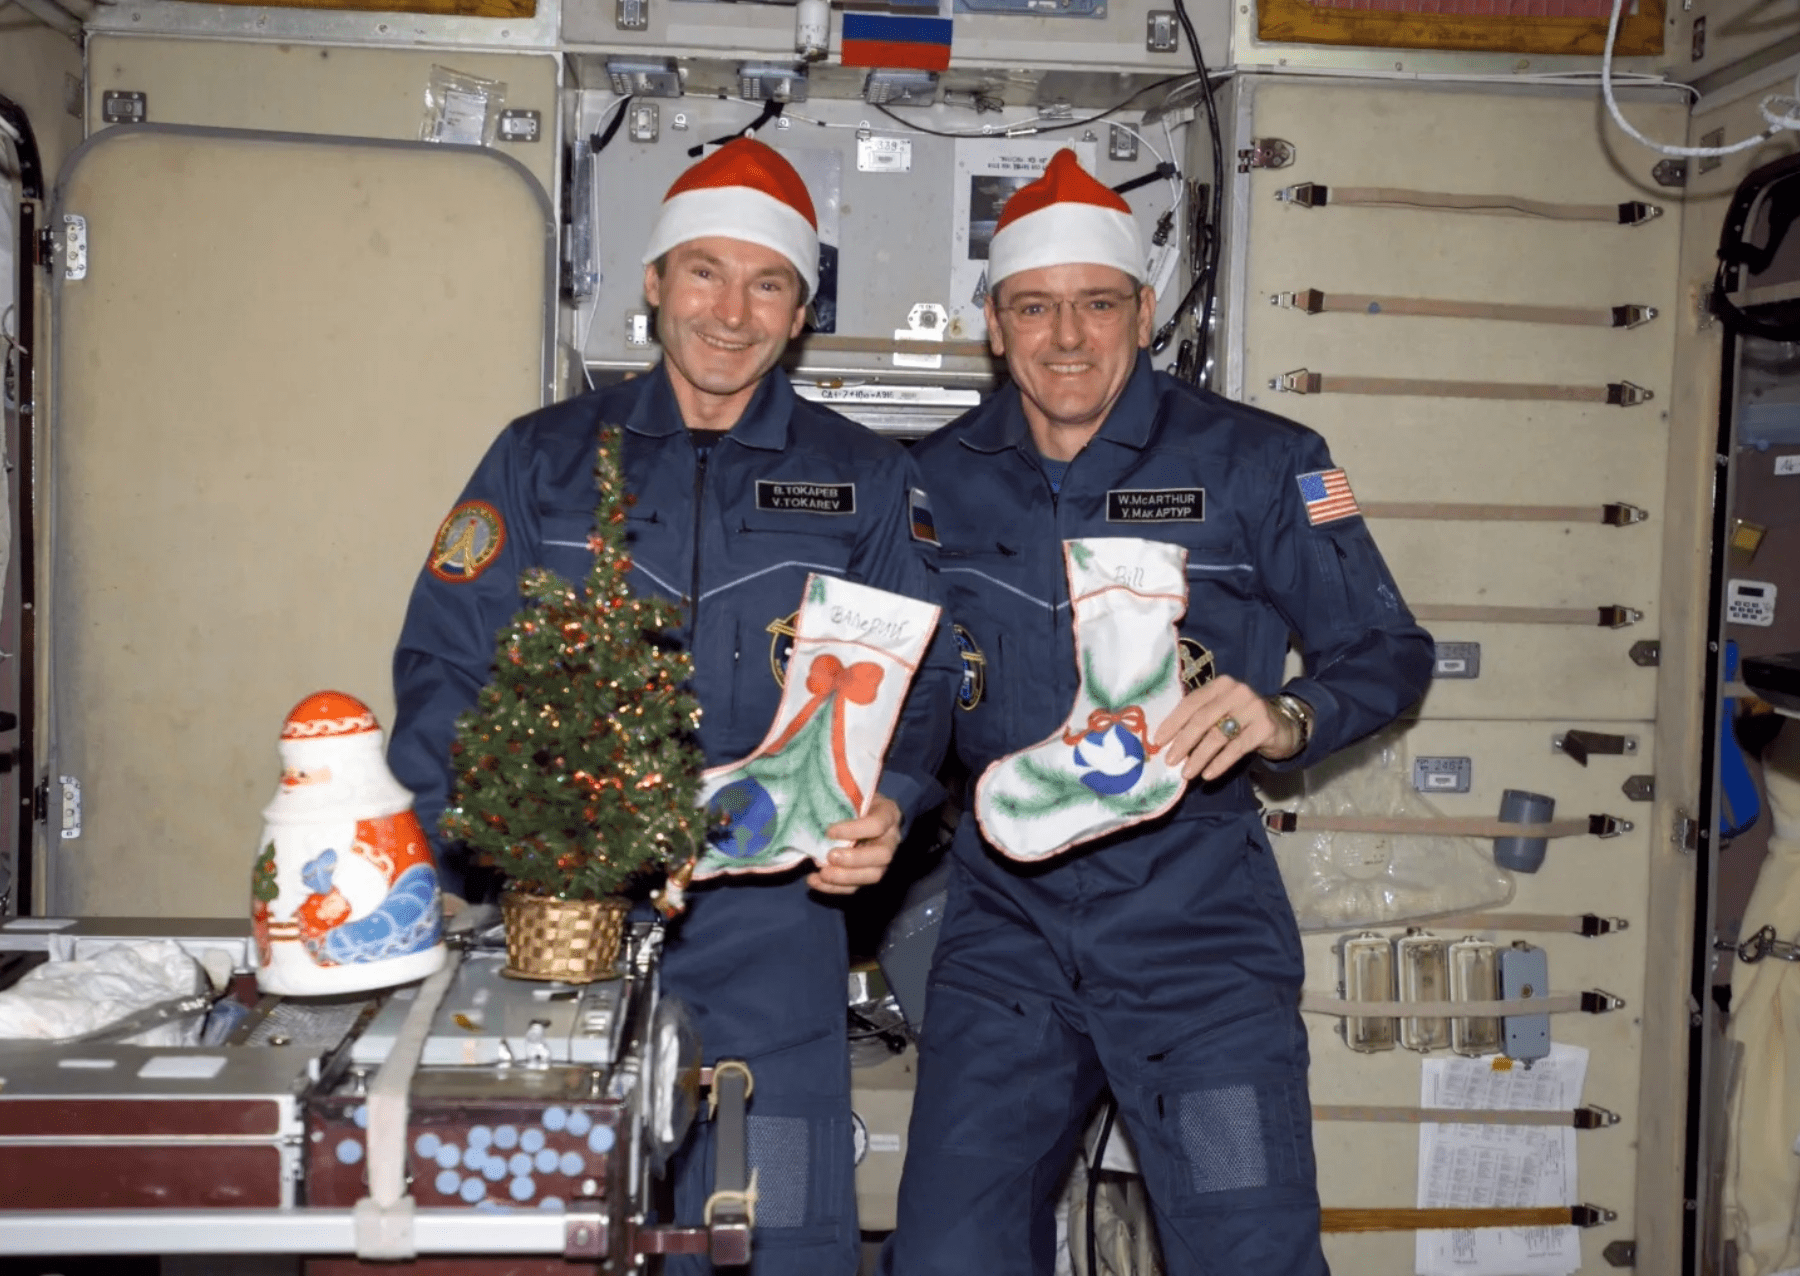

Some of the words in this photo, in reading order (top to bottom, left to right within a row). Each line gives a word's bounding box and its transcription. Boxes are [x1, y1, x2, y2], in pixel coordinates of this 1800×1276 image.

[773, 486, 838, 498] В.ТОКАРЕВ
[771, 497, 840, 510] V.TOKAREV
[1118, 493, 1195, 505] W.McARTHUR
[1114, 565, 1144, 588] Bill
